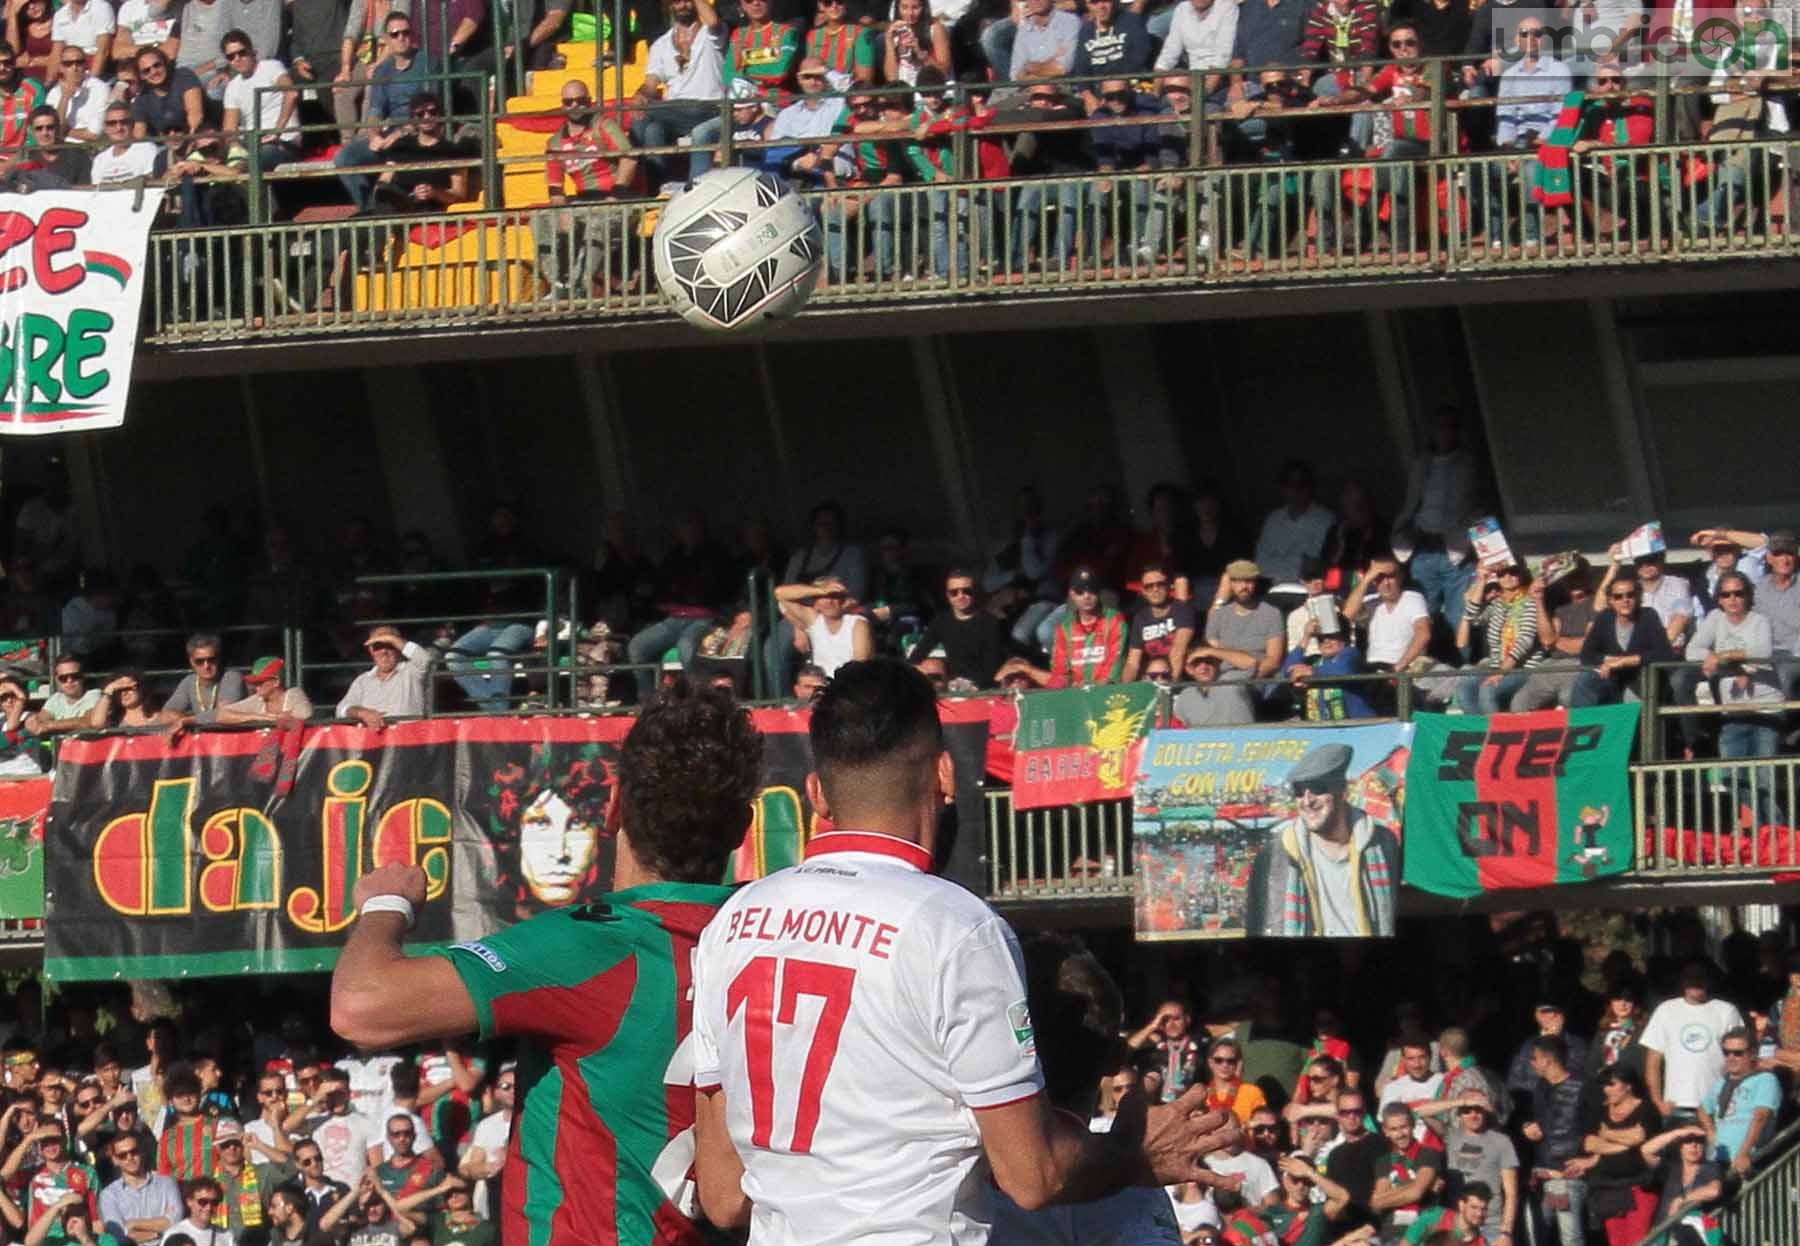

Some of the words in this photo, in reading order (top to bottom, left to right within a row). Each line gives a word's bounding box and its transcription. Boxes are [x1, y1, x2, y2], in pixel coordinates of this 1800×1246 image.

[0, 308, 113, 403] RE
[1437, 724, 1604, 781] STEP
[94, 760, 451, 932] daje
[1457, 800, 1540, 856] ON
[726, 907, 899, 959] BELMONTE
[726, 955, 857, 1154] 17
